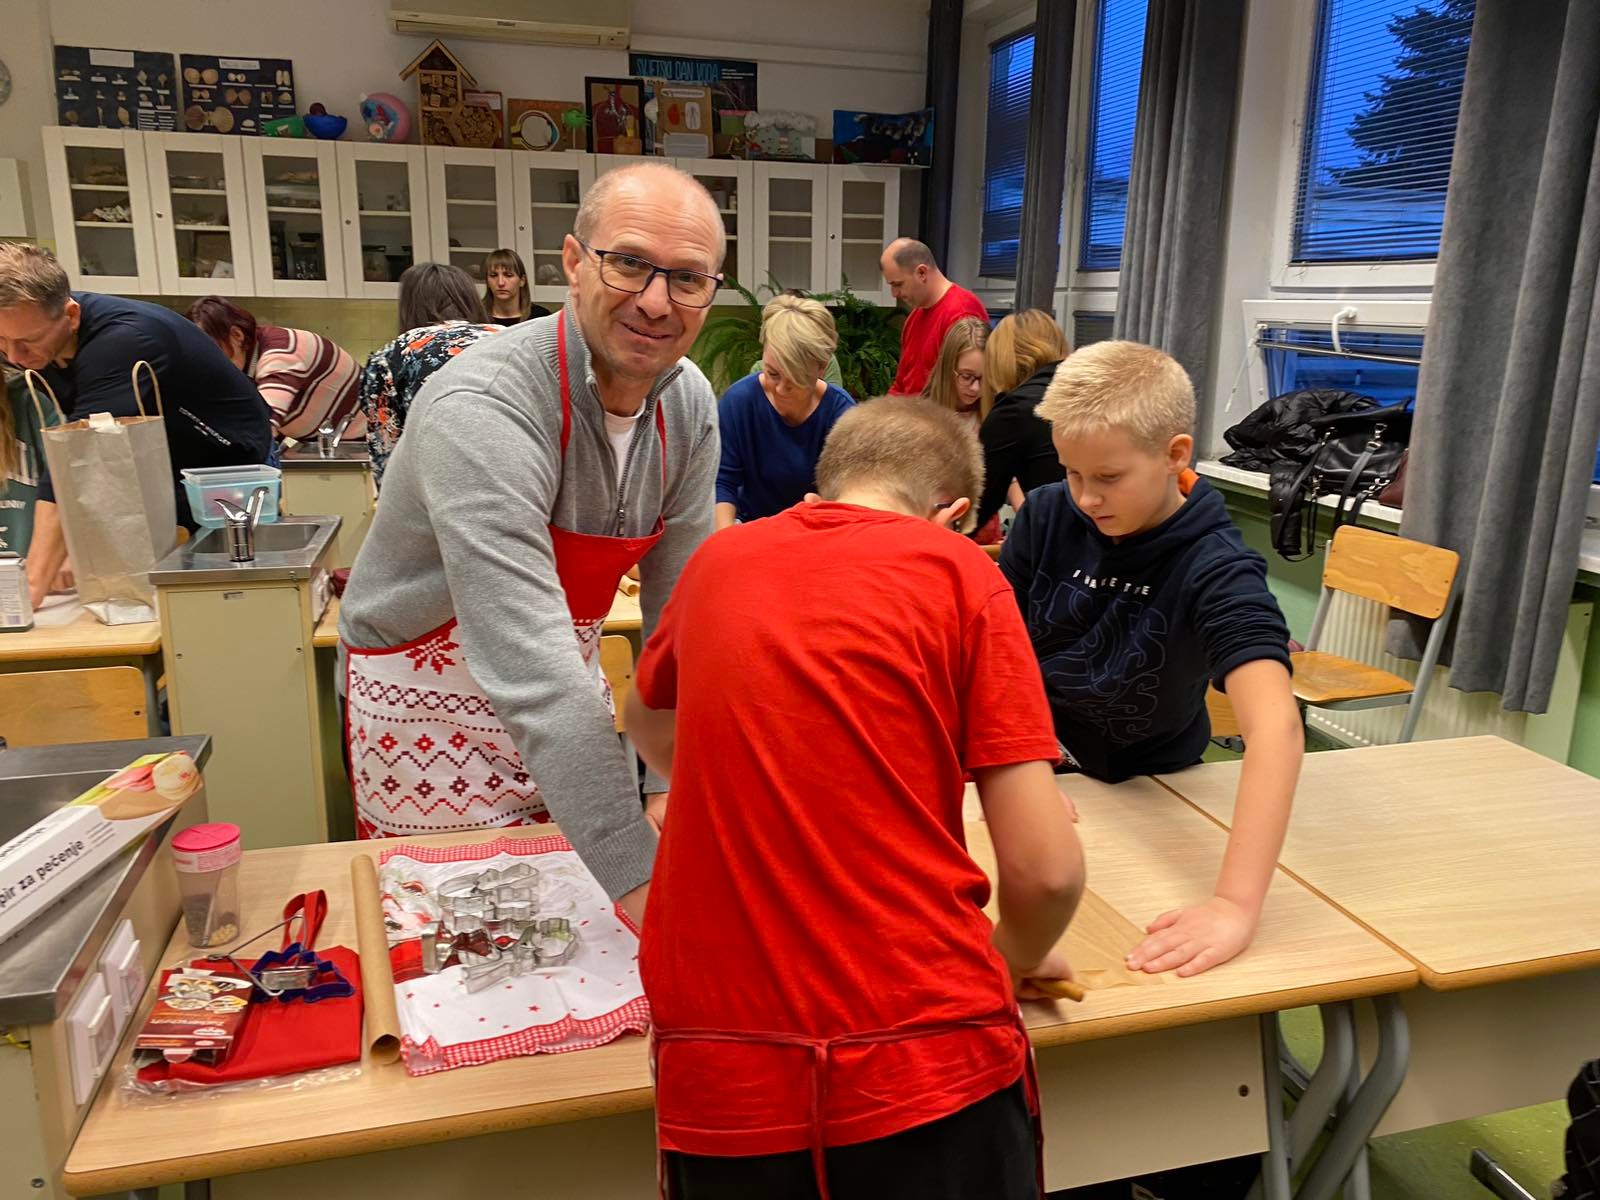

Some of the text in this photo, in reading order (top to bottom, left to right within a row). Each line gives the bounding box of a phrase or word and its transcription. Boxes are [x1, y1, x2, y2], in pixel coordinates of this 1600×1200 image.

[674, 60, 694, 81] DAN
[18, 874, 36, 890] za
[36, 840, 84, 880] pečenje
